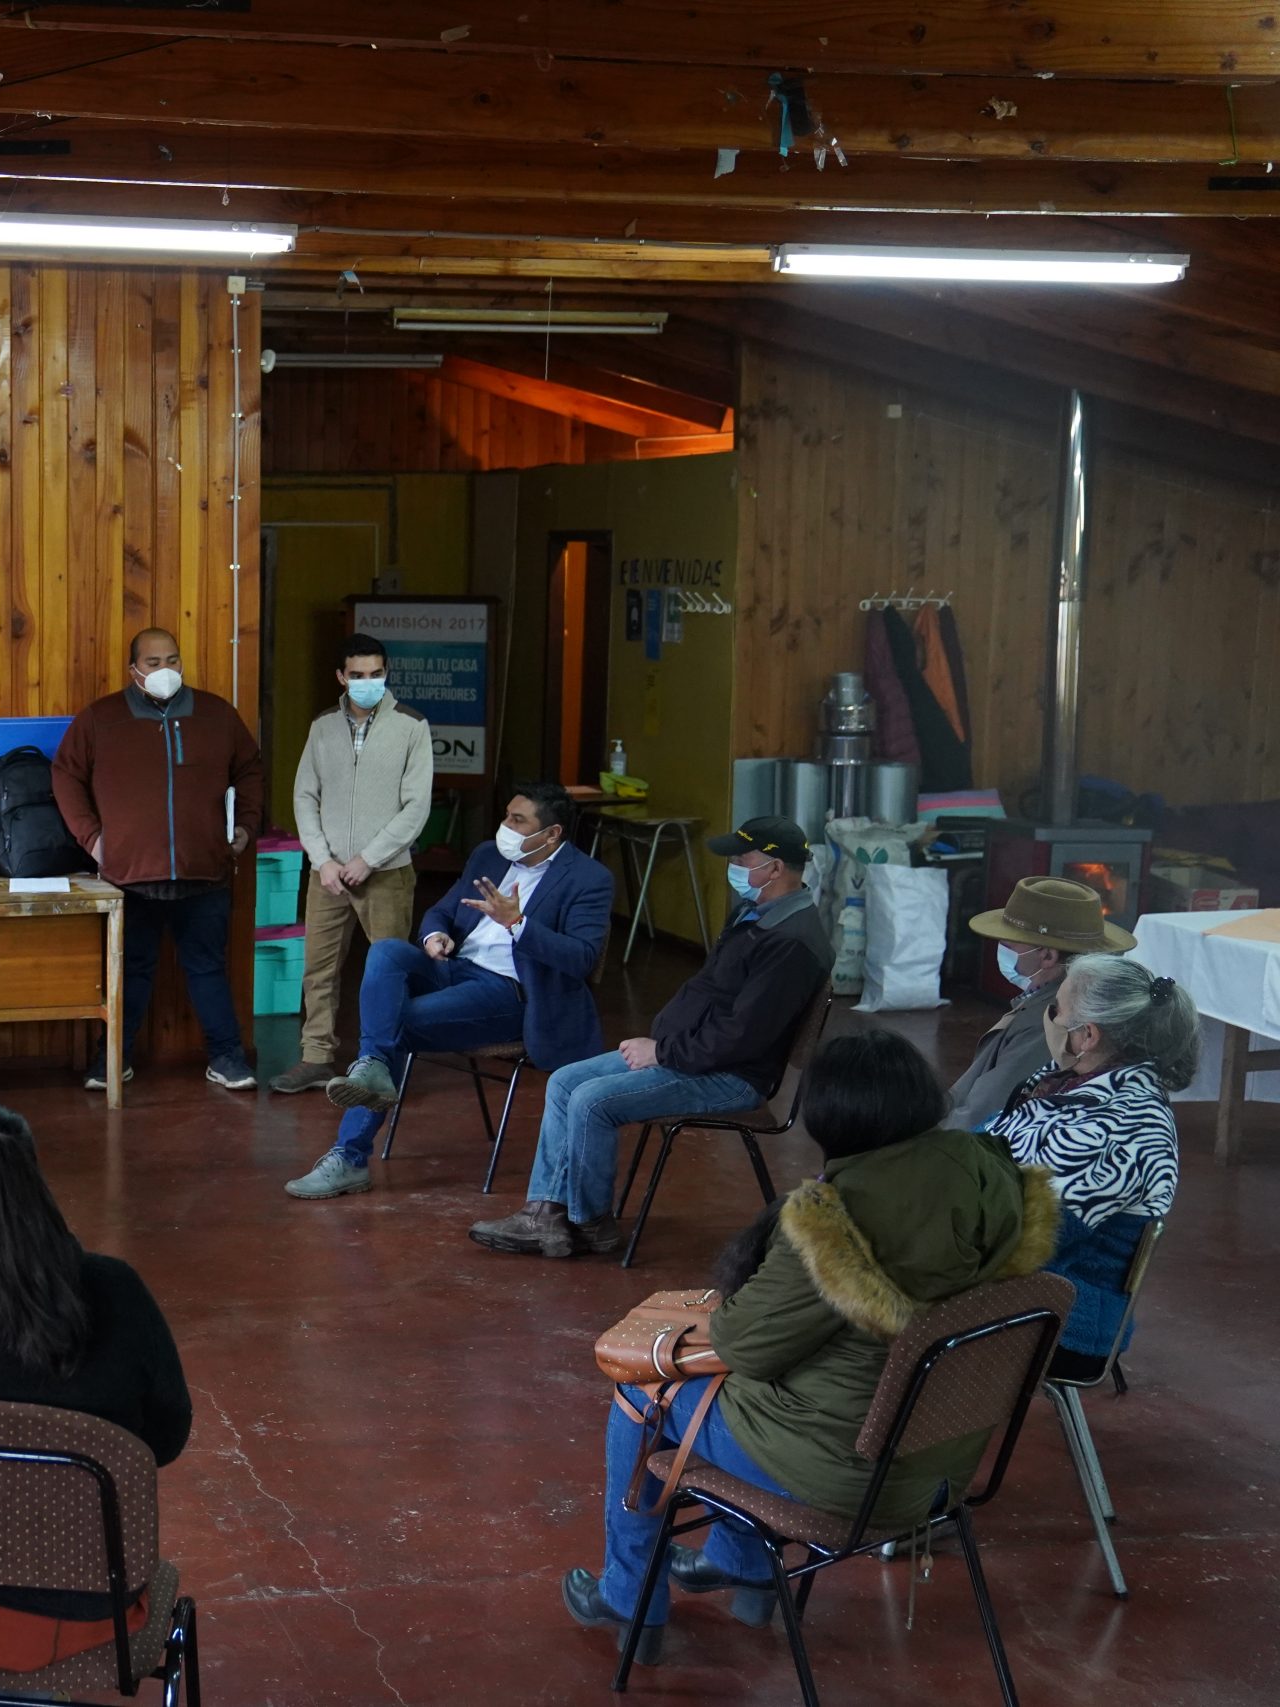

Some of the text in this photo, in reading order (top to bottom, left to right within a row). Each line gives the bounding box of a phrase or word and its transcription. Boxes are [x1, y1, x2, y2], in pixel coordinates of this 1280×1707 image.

[359, 613, 486, 631] ADMISIÓN 2017
[388, 656, 478, 673] VENIDO A TU CASA
[389, 671, 453, 687] DE ESTUDIOS
[392, 687, 477, 702] ICOS SUPERIORES
[432, 739, 475, 757] ON
